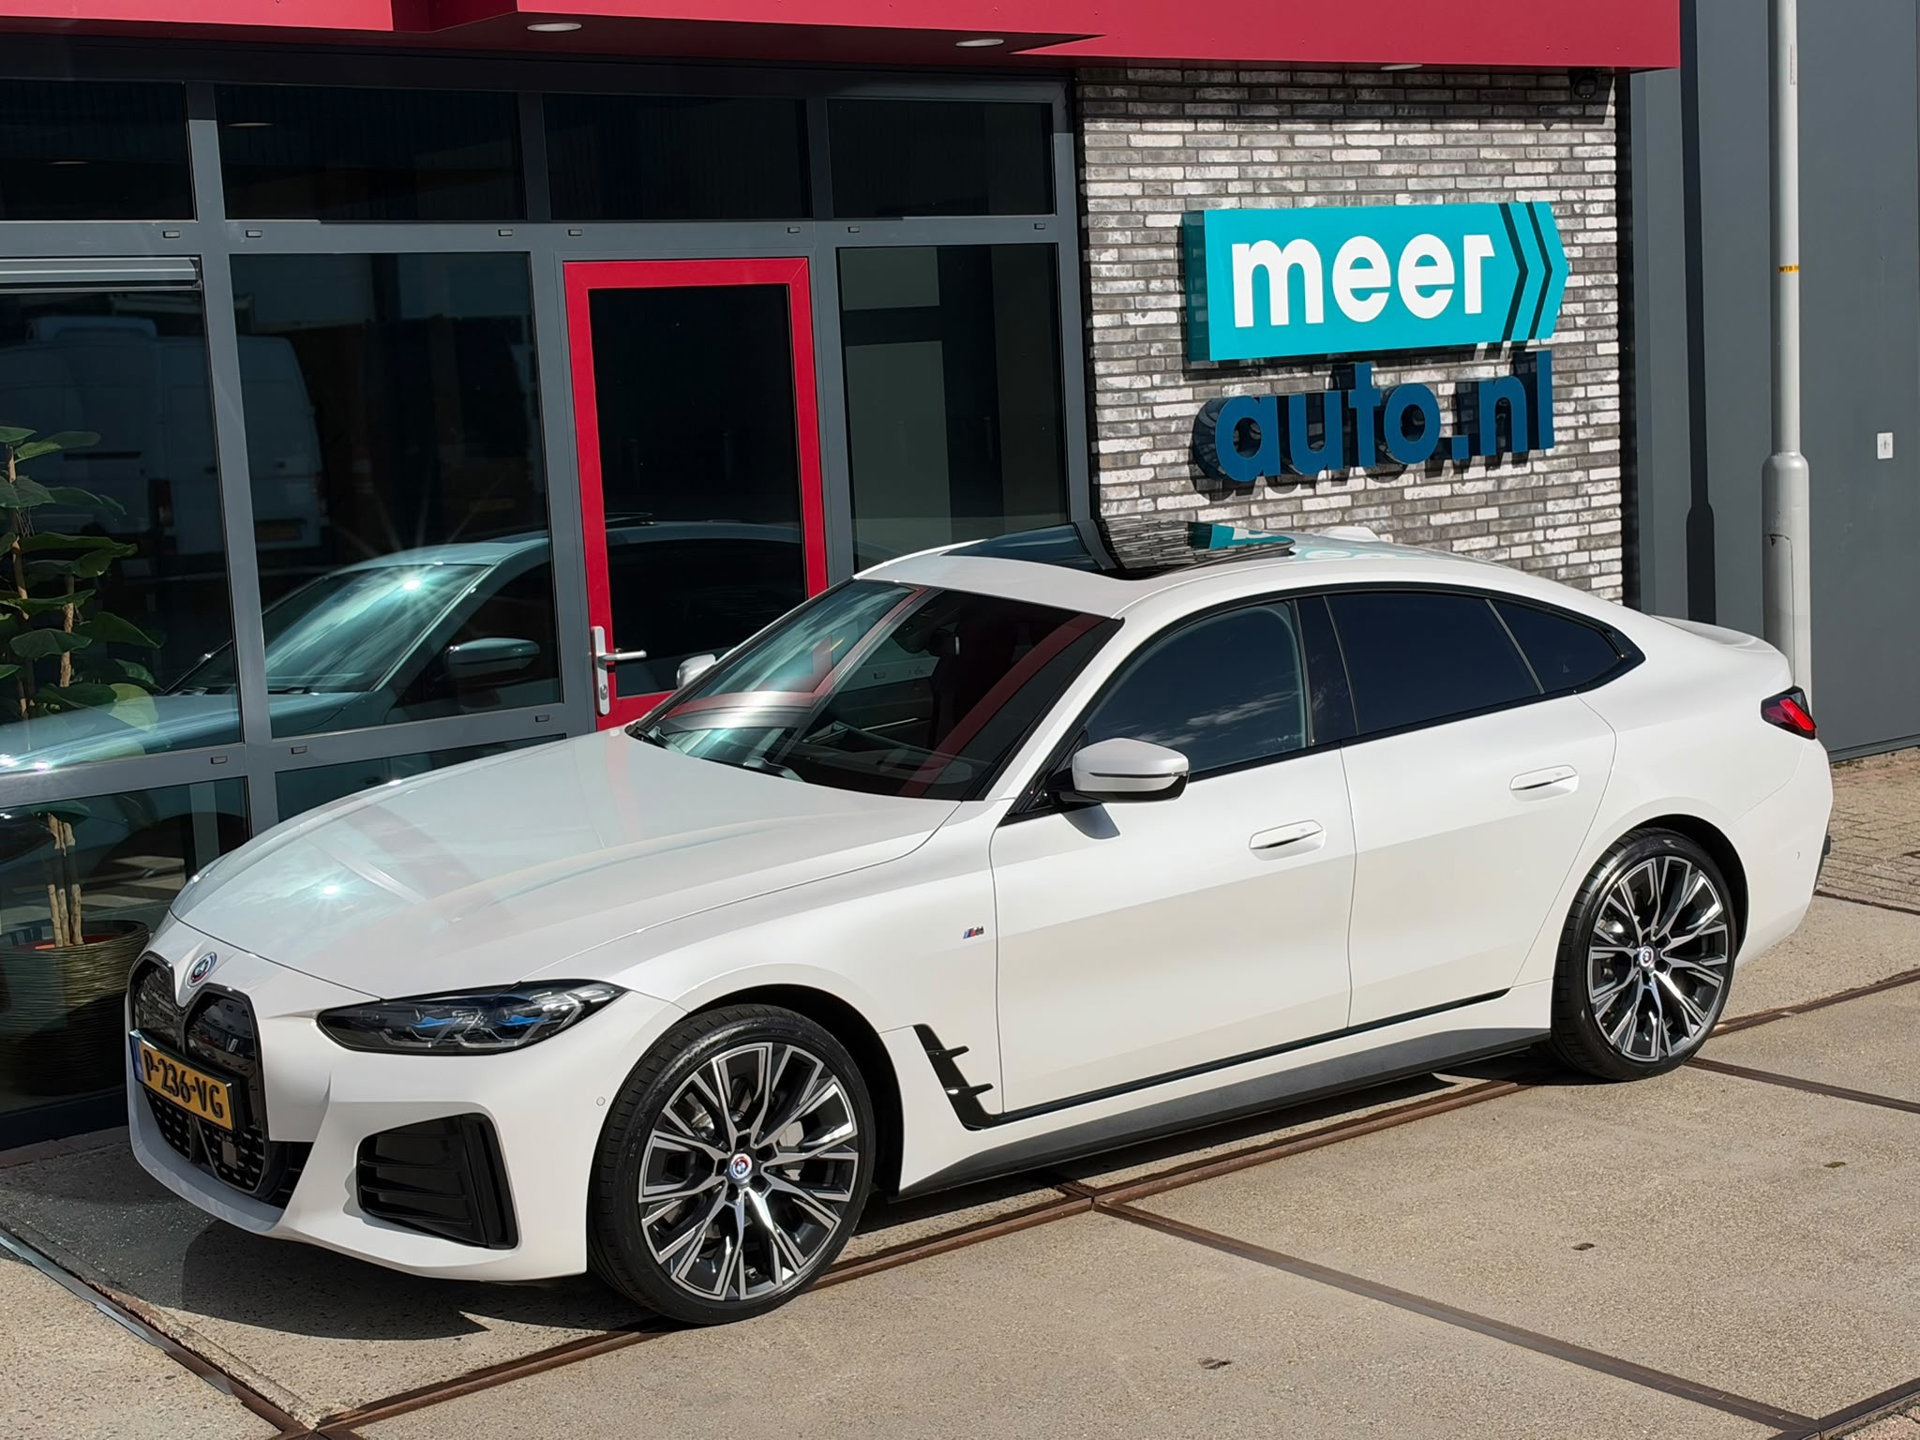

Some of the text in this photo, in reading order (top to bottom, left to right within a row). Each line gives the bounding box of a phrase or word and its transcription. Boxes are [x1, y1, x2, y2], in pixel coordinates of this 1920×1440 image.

[1232, 233, 1495, 328] meer
[1214, 350, 1555, 482] auto.nl
[143, 1049, 224, 1119] P-236-VG
